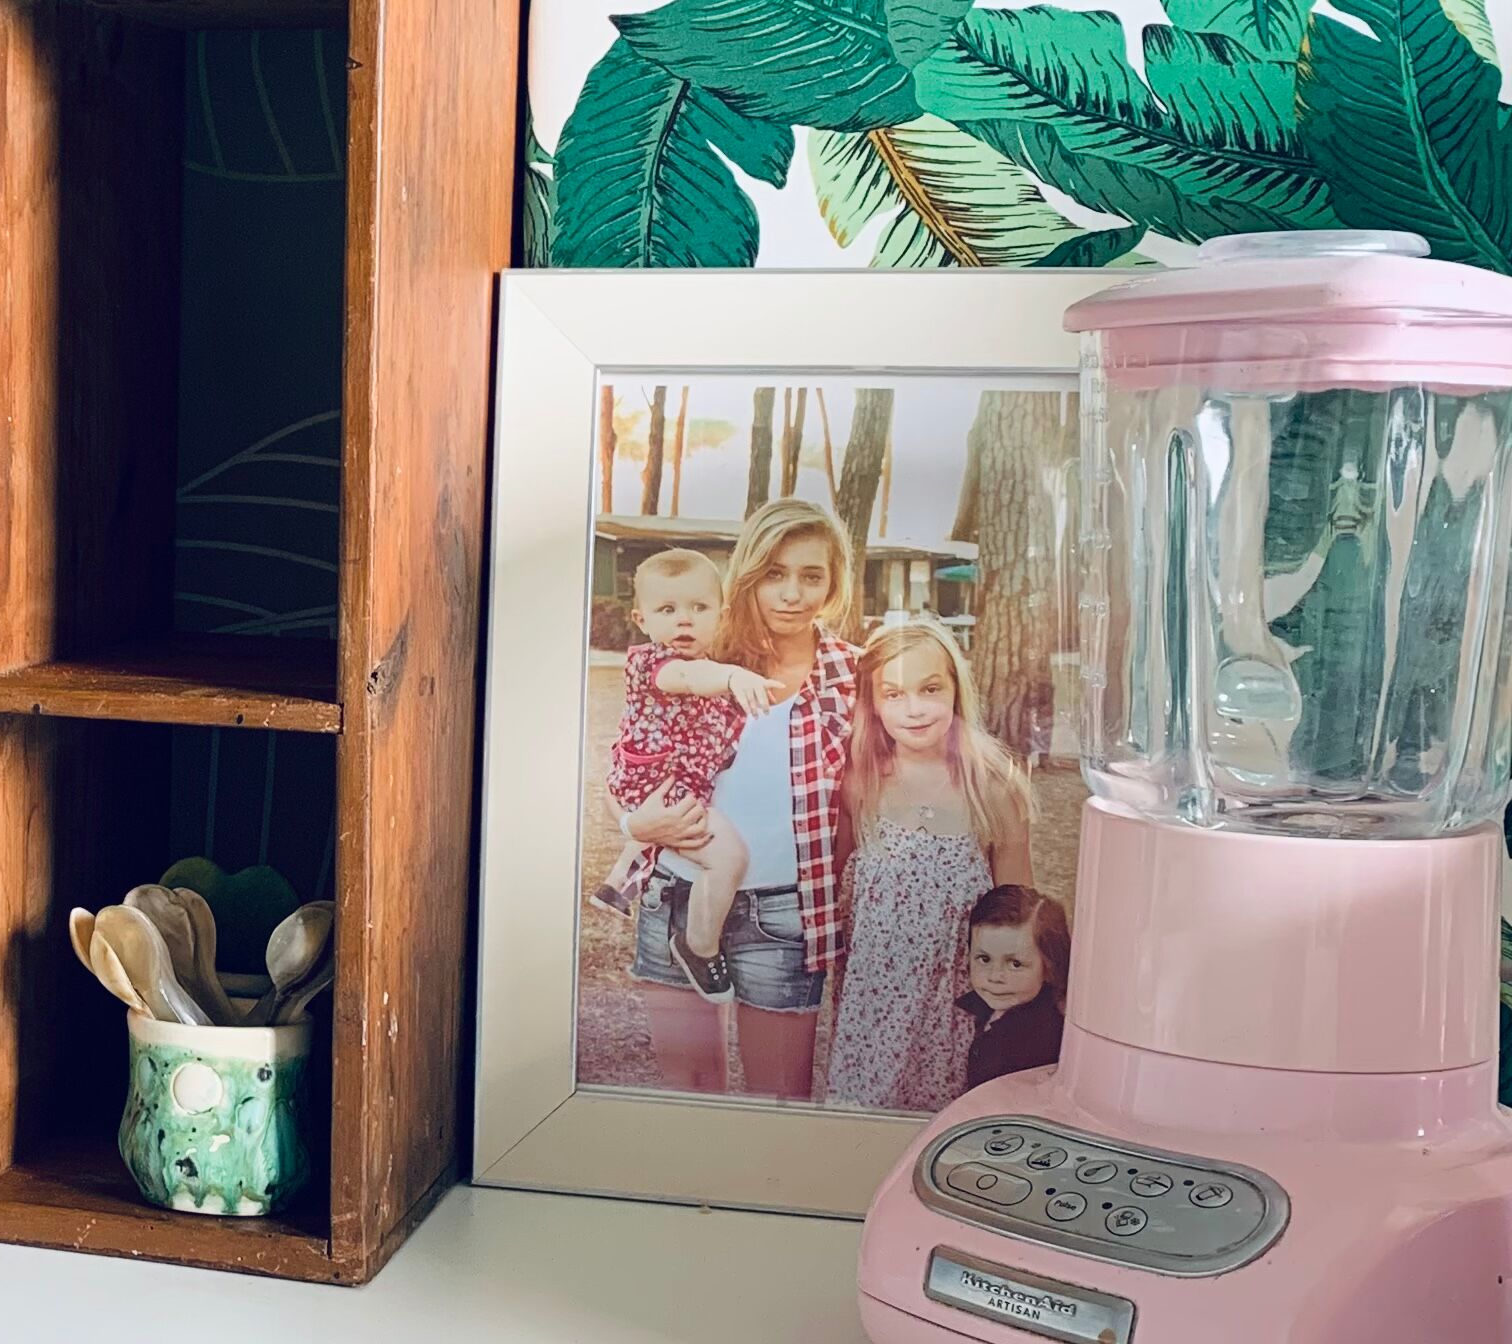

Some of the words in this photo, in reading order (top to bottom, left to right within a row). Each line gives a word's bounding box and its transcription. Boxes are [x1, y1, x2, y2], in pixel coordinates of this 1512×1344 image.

[1054, 1200, 1076, 1210] Pulse
[961, 1271, 1076, 1316] KitchenAid
[987, 1296, 1041, 1321] ARTISAN
